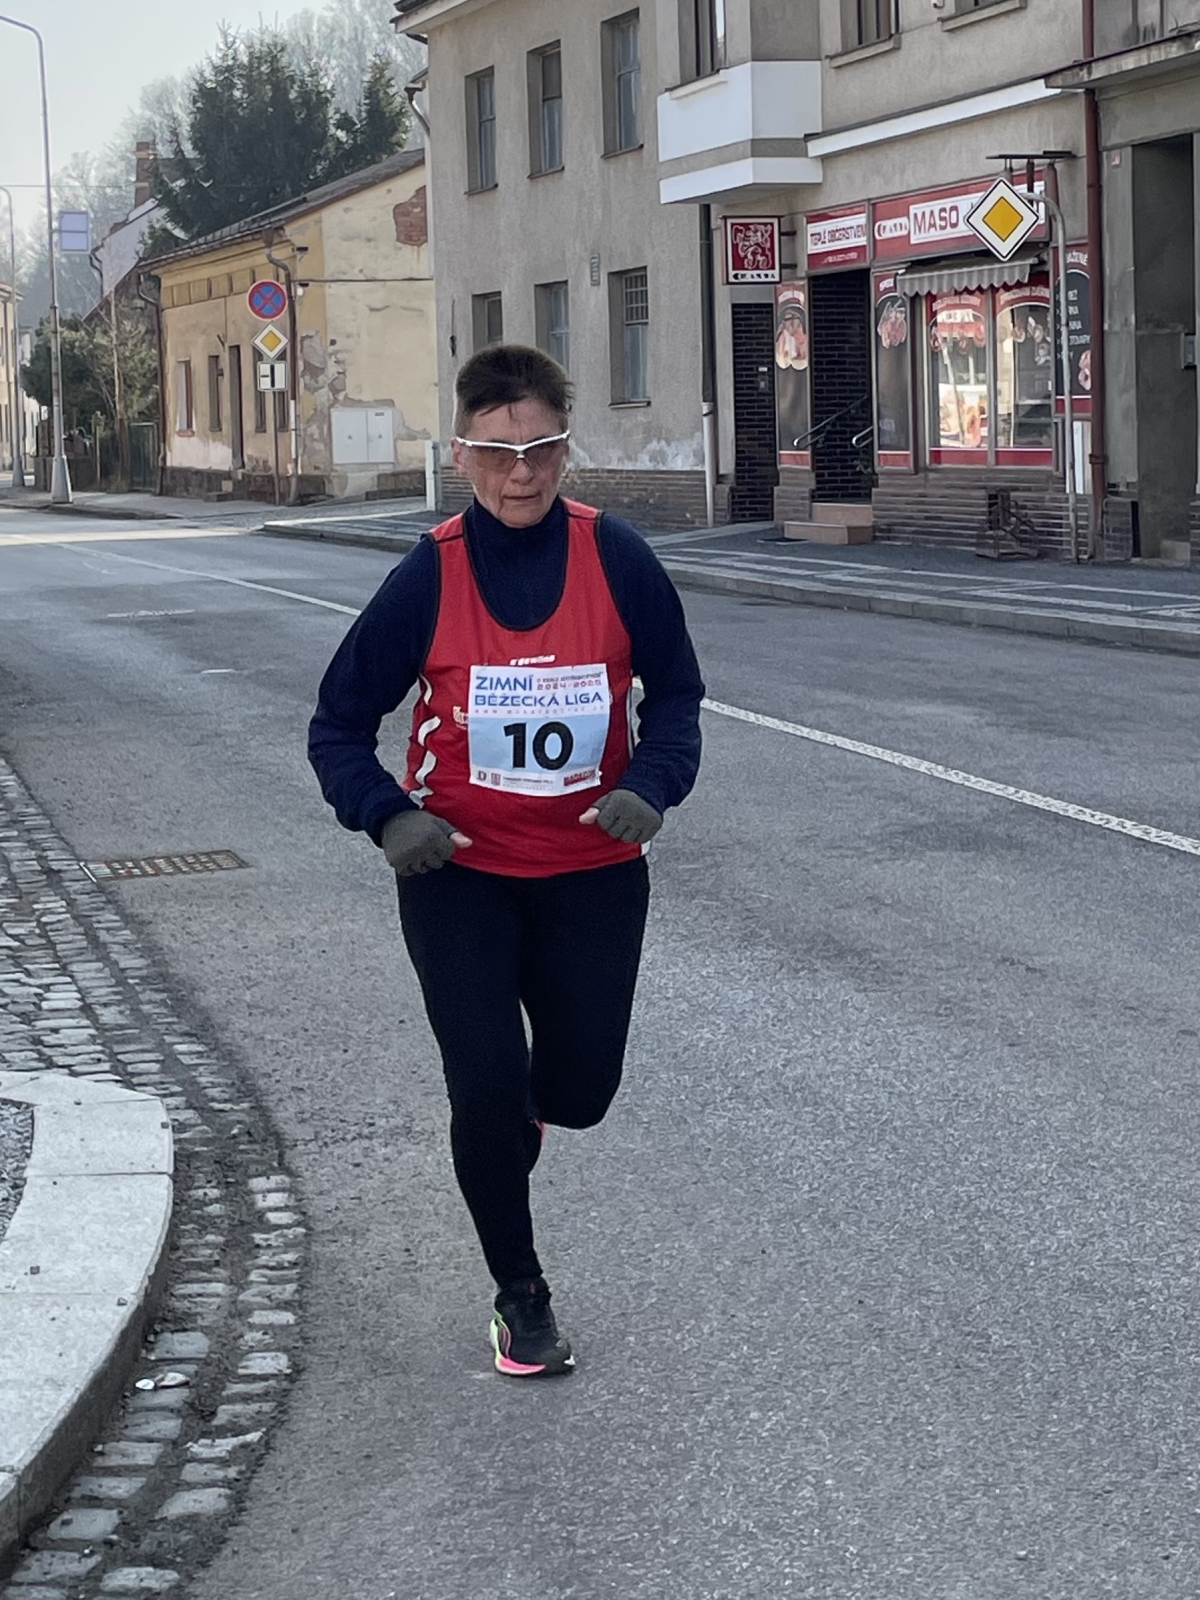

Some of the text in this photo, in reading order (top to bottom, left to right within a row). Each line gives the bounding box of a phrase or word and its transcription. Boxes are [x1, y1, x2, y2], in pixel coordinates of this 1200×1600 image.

[913, 205, 960, 234] MASO
[475, 674, 533, 691] ZIMNÍ
[474, 691, 604, 707] BĚŽECKÁ LIGA
[503, 721, 574, 770] 10
